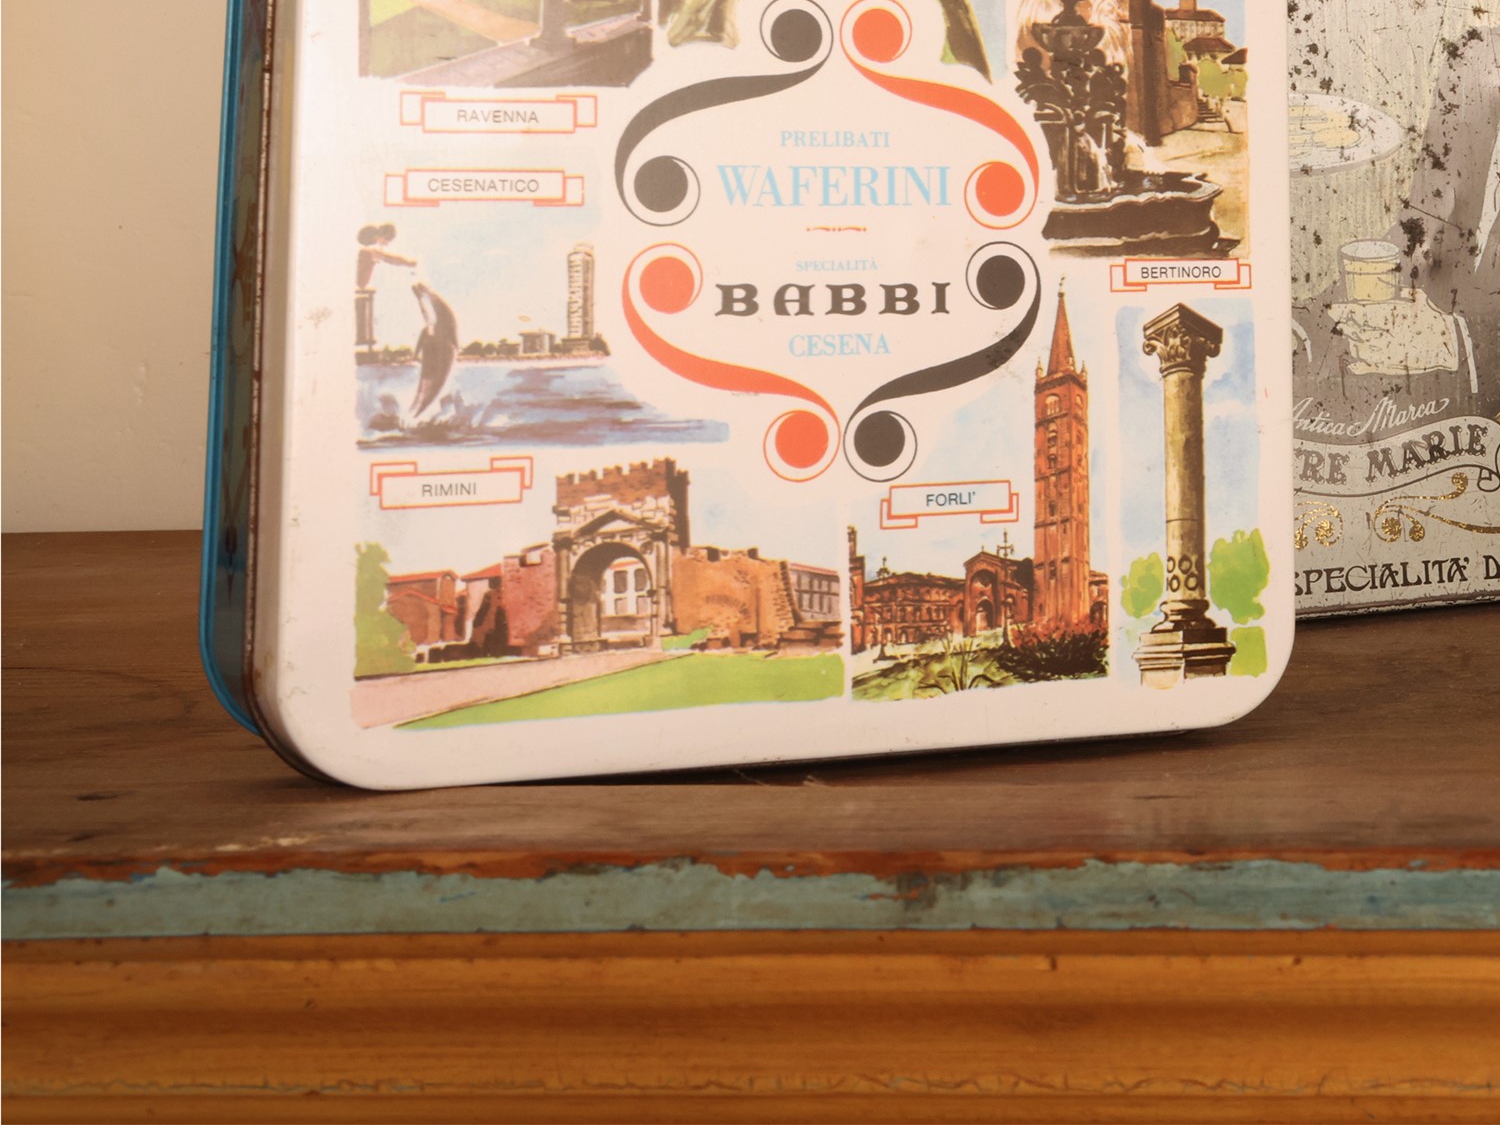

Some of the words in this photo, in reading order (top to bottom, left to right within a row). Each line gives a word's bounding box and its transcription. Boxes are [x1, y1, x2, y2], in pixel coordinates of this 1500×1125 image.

[456, 107, 540, 125] RAVENNA
[779, 131, 890, 149] PRELIBATI
[427, 176, 540, 195] CESENATICO
[716, 164, 952, 208] WAFERINI
[1140, 263, 1223, 280] BERTINORO
[714, 281, 951, 318] BABBI
[788, 332, 891, 359] CESENA
[1348, 396, 1450, 436] Marca
[1365, 424, 1489, 484] MARIE
[421, 480, 478, 499] RIMINI
